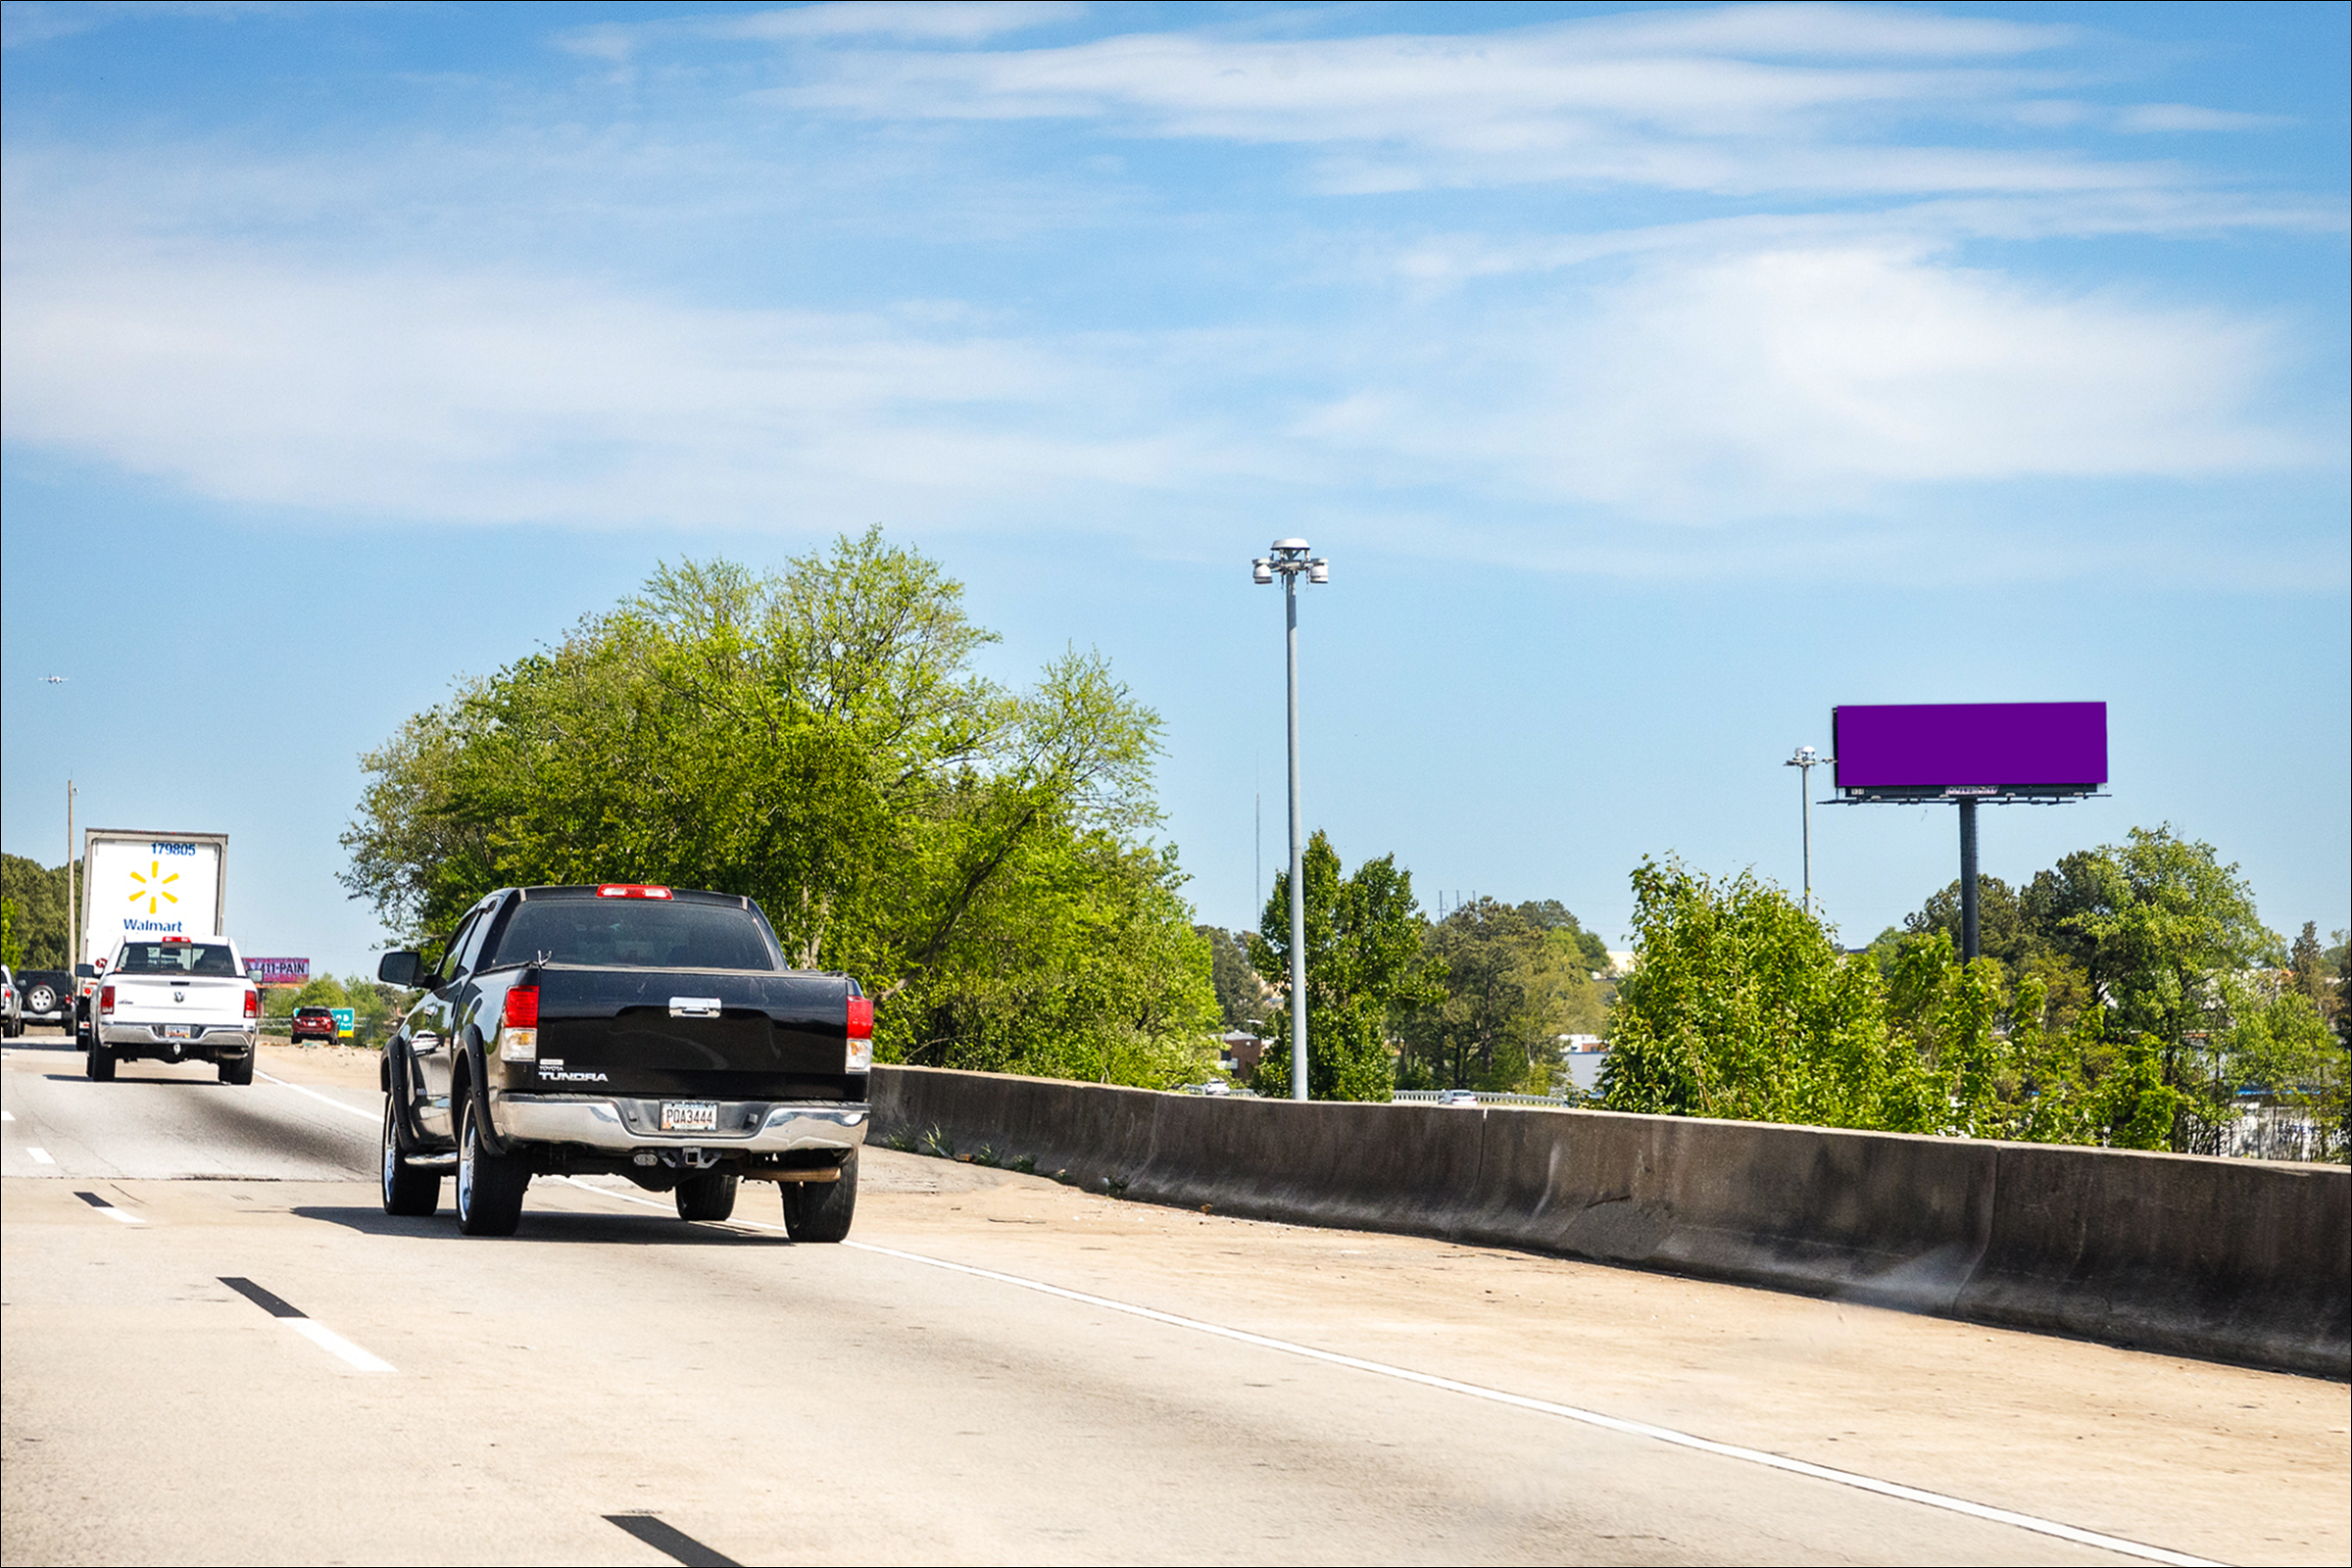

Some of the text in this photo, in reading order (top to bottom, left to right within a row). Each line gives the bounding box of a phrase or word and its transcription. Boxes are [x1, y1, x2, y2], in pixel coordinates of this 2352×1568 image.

[151, 842, 196, 856] 179805
[123, 918, 182, 932] Walmart
[538, 1071, 609, 1082] TUNDRA
